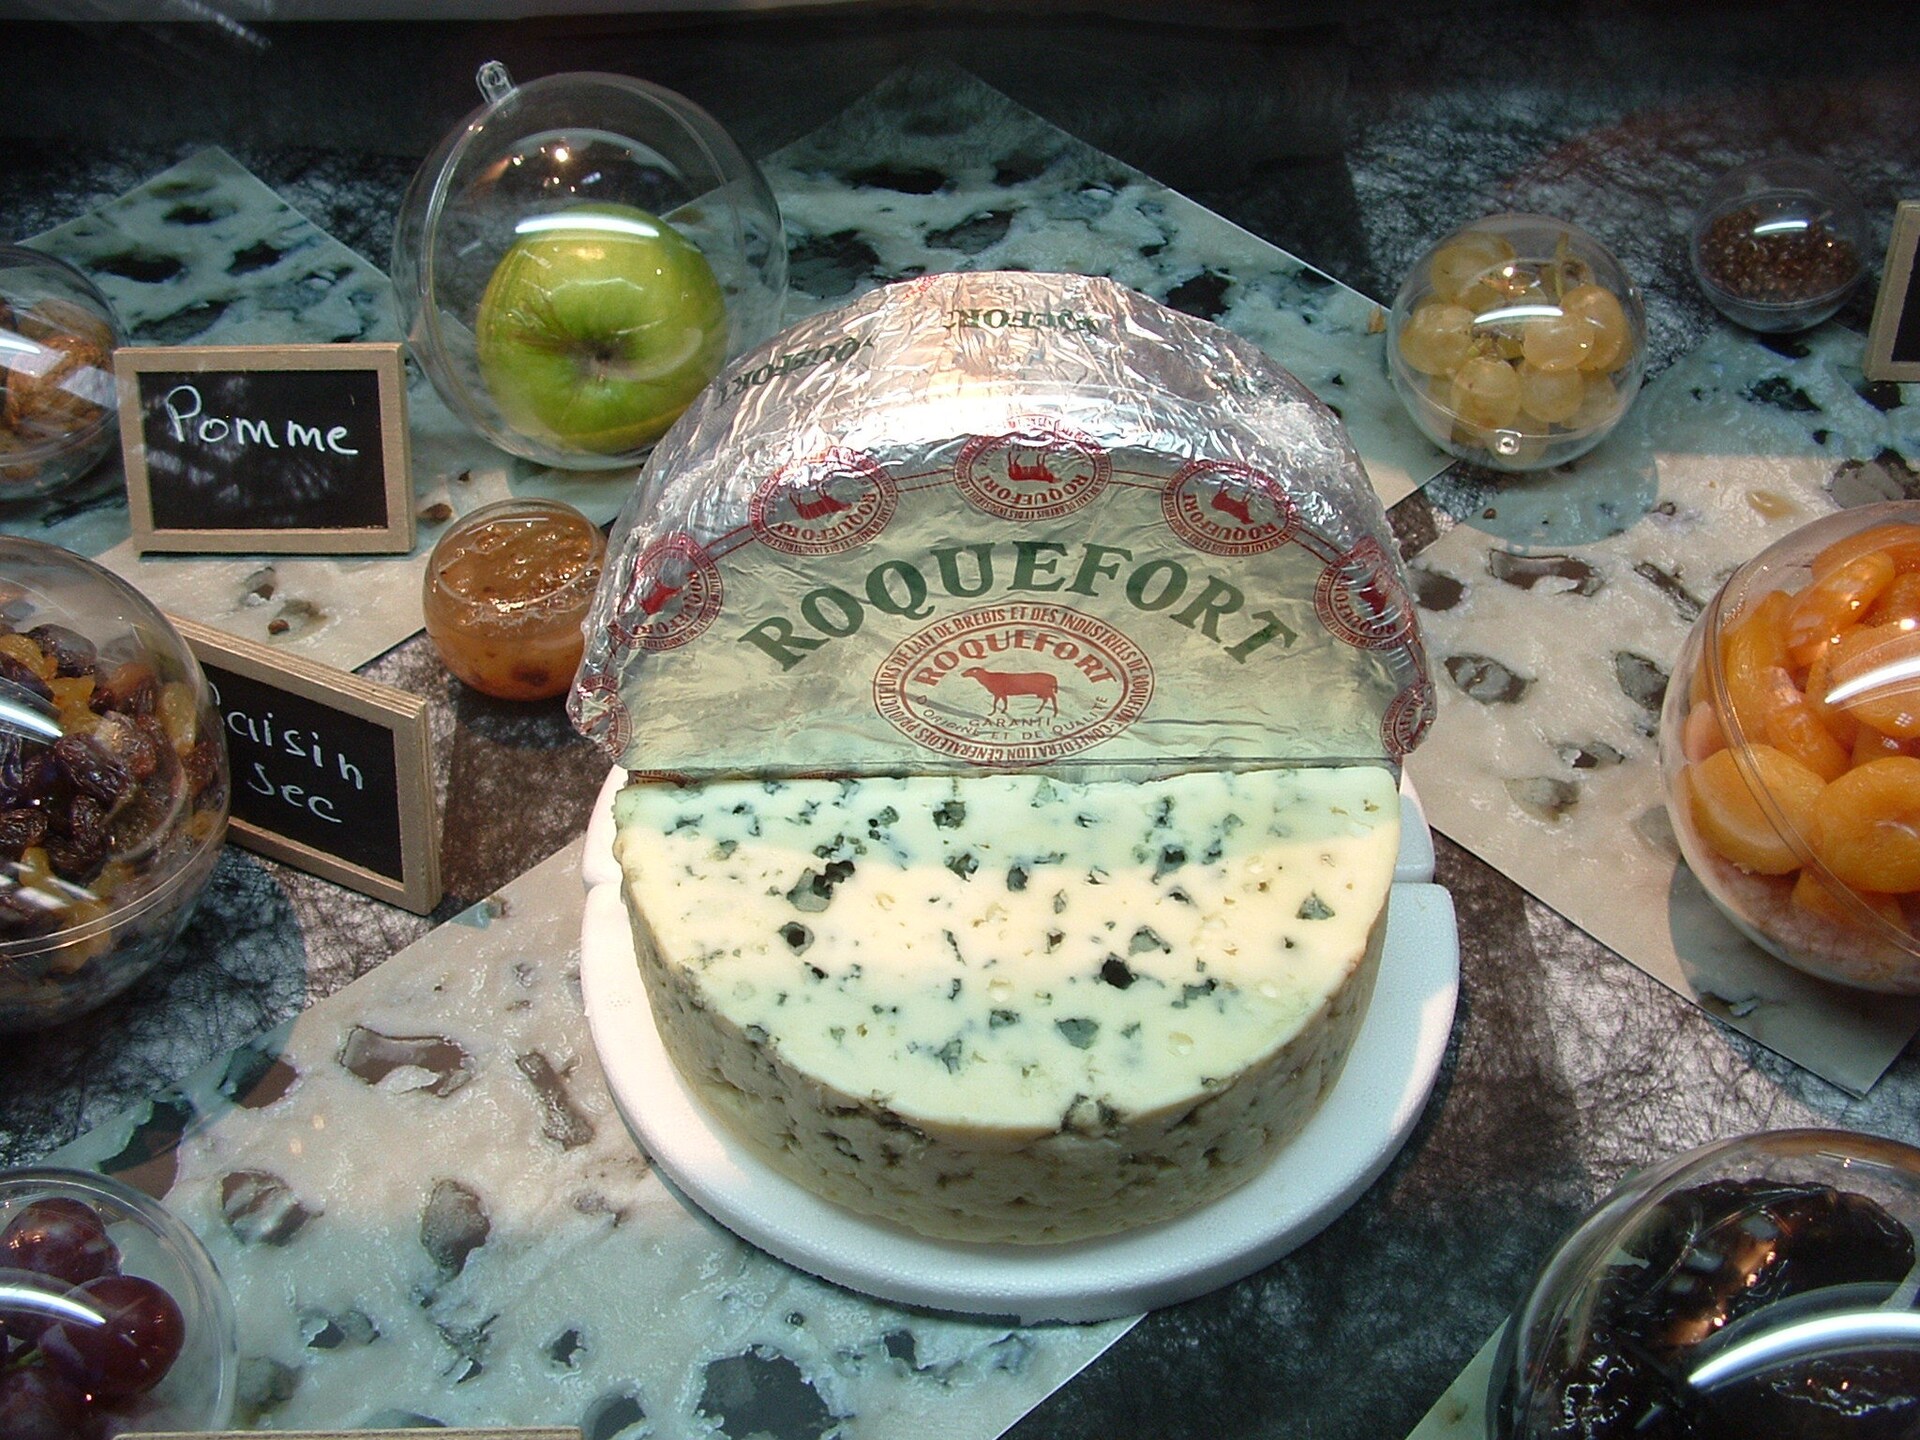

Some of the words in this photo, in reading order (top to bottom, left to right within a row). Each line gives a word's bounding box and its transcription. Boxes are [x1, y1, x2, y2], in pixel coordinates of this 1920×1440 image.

[165, 385, 358, 455] Pomme
[978, 474, 1090, 507] ROQUEFORT
[738, 540, 1298, 672] ROQUEFORT
[891, 647, 915, 668] DE
[904, 632, 937, 656] LAIT
[933, 622, 955, 639] DE
[953, 608, 1006, 631] BREBIS
[1010, 606, 1029, 620] ET
[1030, 607, 1059, 623] DES
[1060, 612, 1137, 662] INDUSTRIELS
[1126, 658, 1148, 675] DE
[913, 629, 1118, 687] ROQUEFORT
[209, 681, 364, 791] aisin
